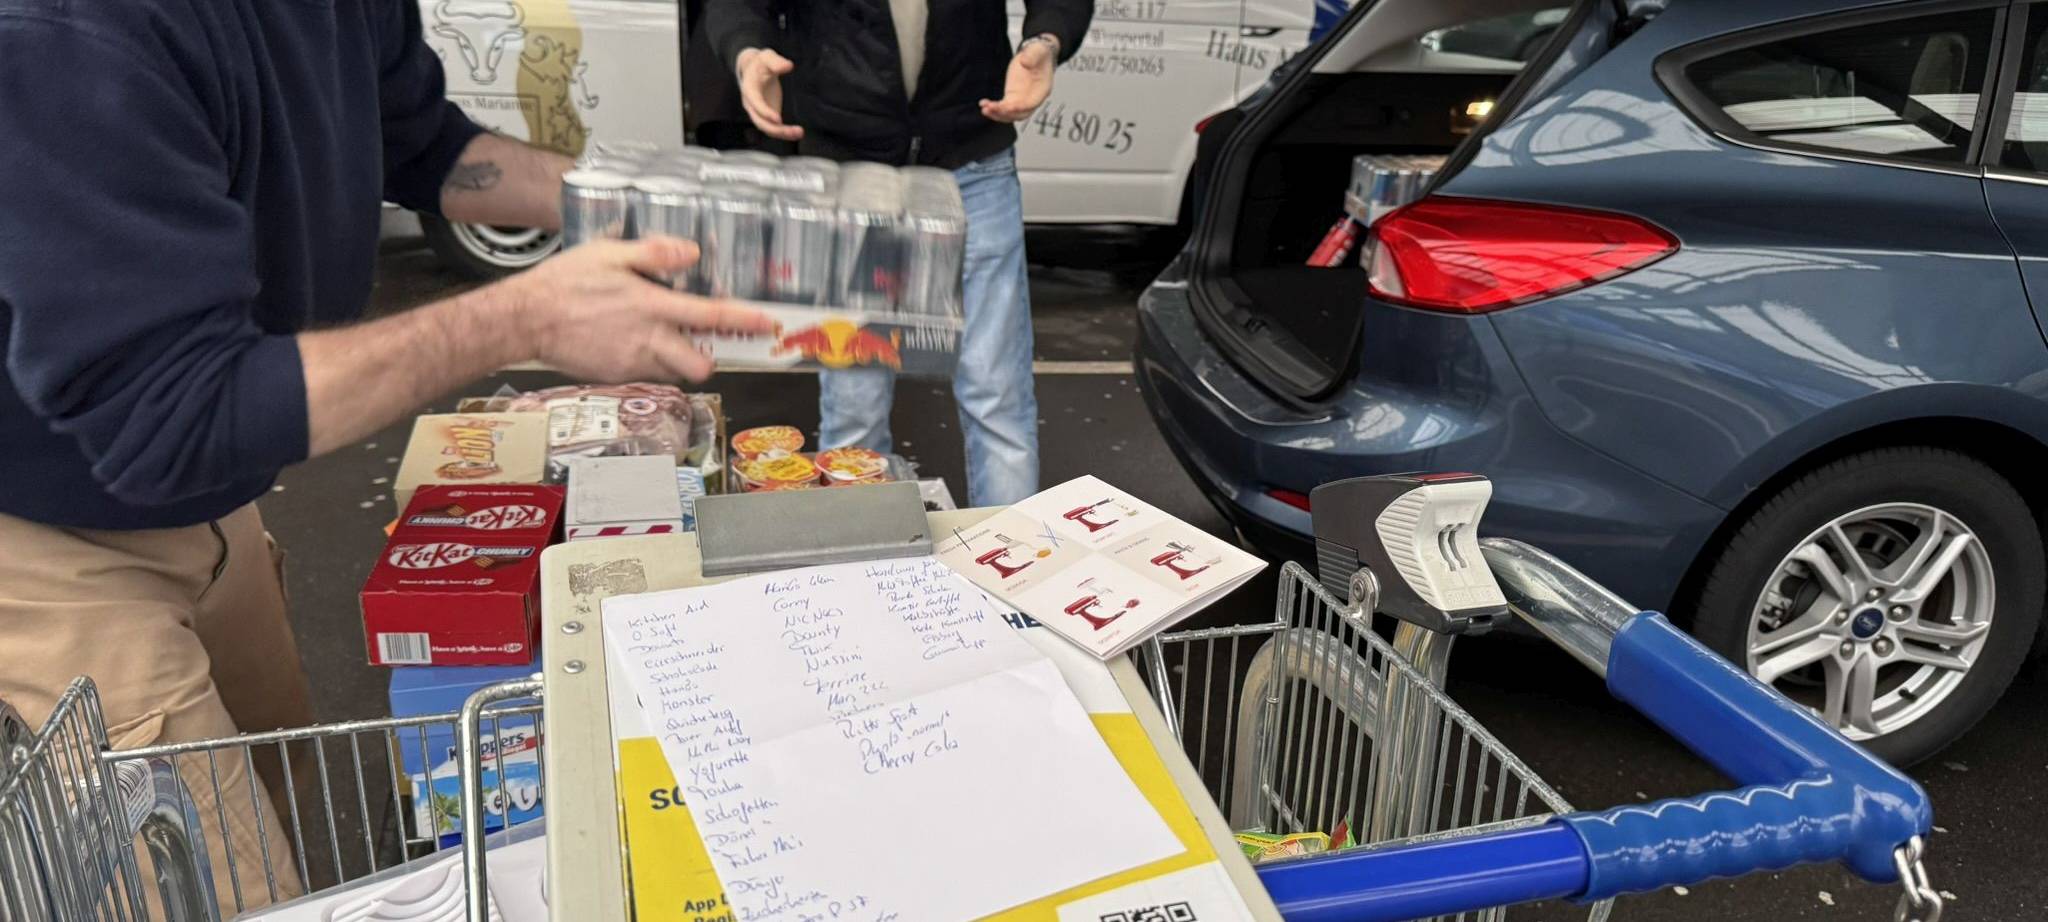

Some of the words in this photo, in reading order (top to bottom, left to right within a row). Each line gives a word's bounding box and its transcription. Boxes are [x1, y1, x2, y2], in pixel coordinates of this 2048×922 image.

[1137, 1, 1167, 20] 117
[1207, 30, 1269, 69] Haus
[1069, 111, 1100, 146] 80
[1104, 117, 1136, 154] 25
[410, 515, 465, 526] CHUNKY
[468, 505, 542, 530] KitKat
[396, 543, 473, 568] KitKat
[475, 547, 532, 557] CHUNKY
[448, 732, 525, 761] Kppers
[863, 750, 915, 775] Cherry
[683, 898, 716, 913] App
